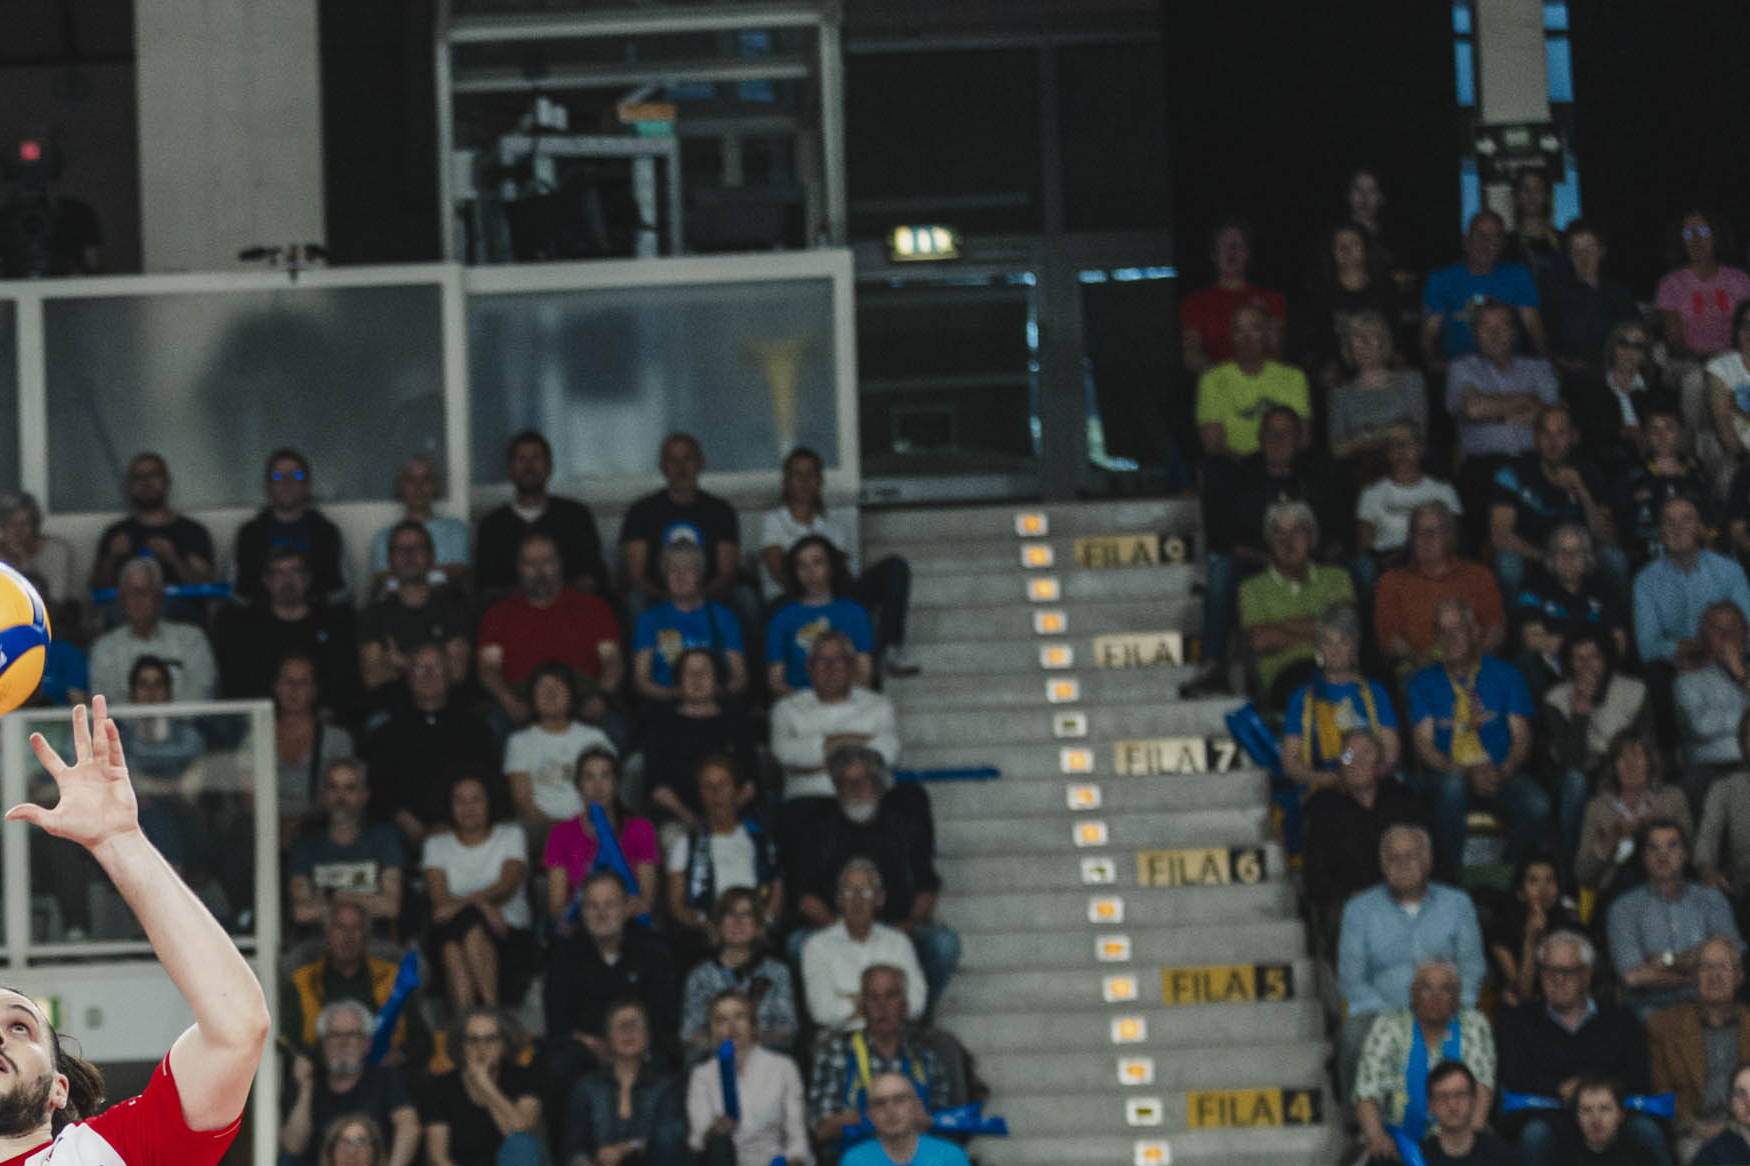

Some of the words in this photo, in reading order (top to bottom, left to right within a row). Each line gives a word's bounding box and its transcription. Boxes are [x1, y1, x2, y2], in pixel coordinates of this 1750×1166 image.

[1127, 738, 1198, 775] FILA
[1212, 740, 1237, 773] 7
[1147, 854, 1225, 886] FILA
[1236, 853, 1261, 885] 6
[1172, 970, 1249, 1002] FILA
[1265, 966, 1287, 999] 5
[1195, 1092, 1277, 1127] FILA
[1288, 1090, 1314, 1124] 4
